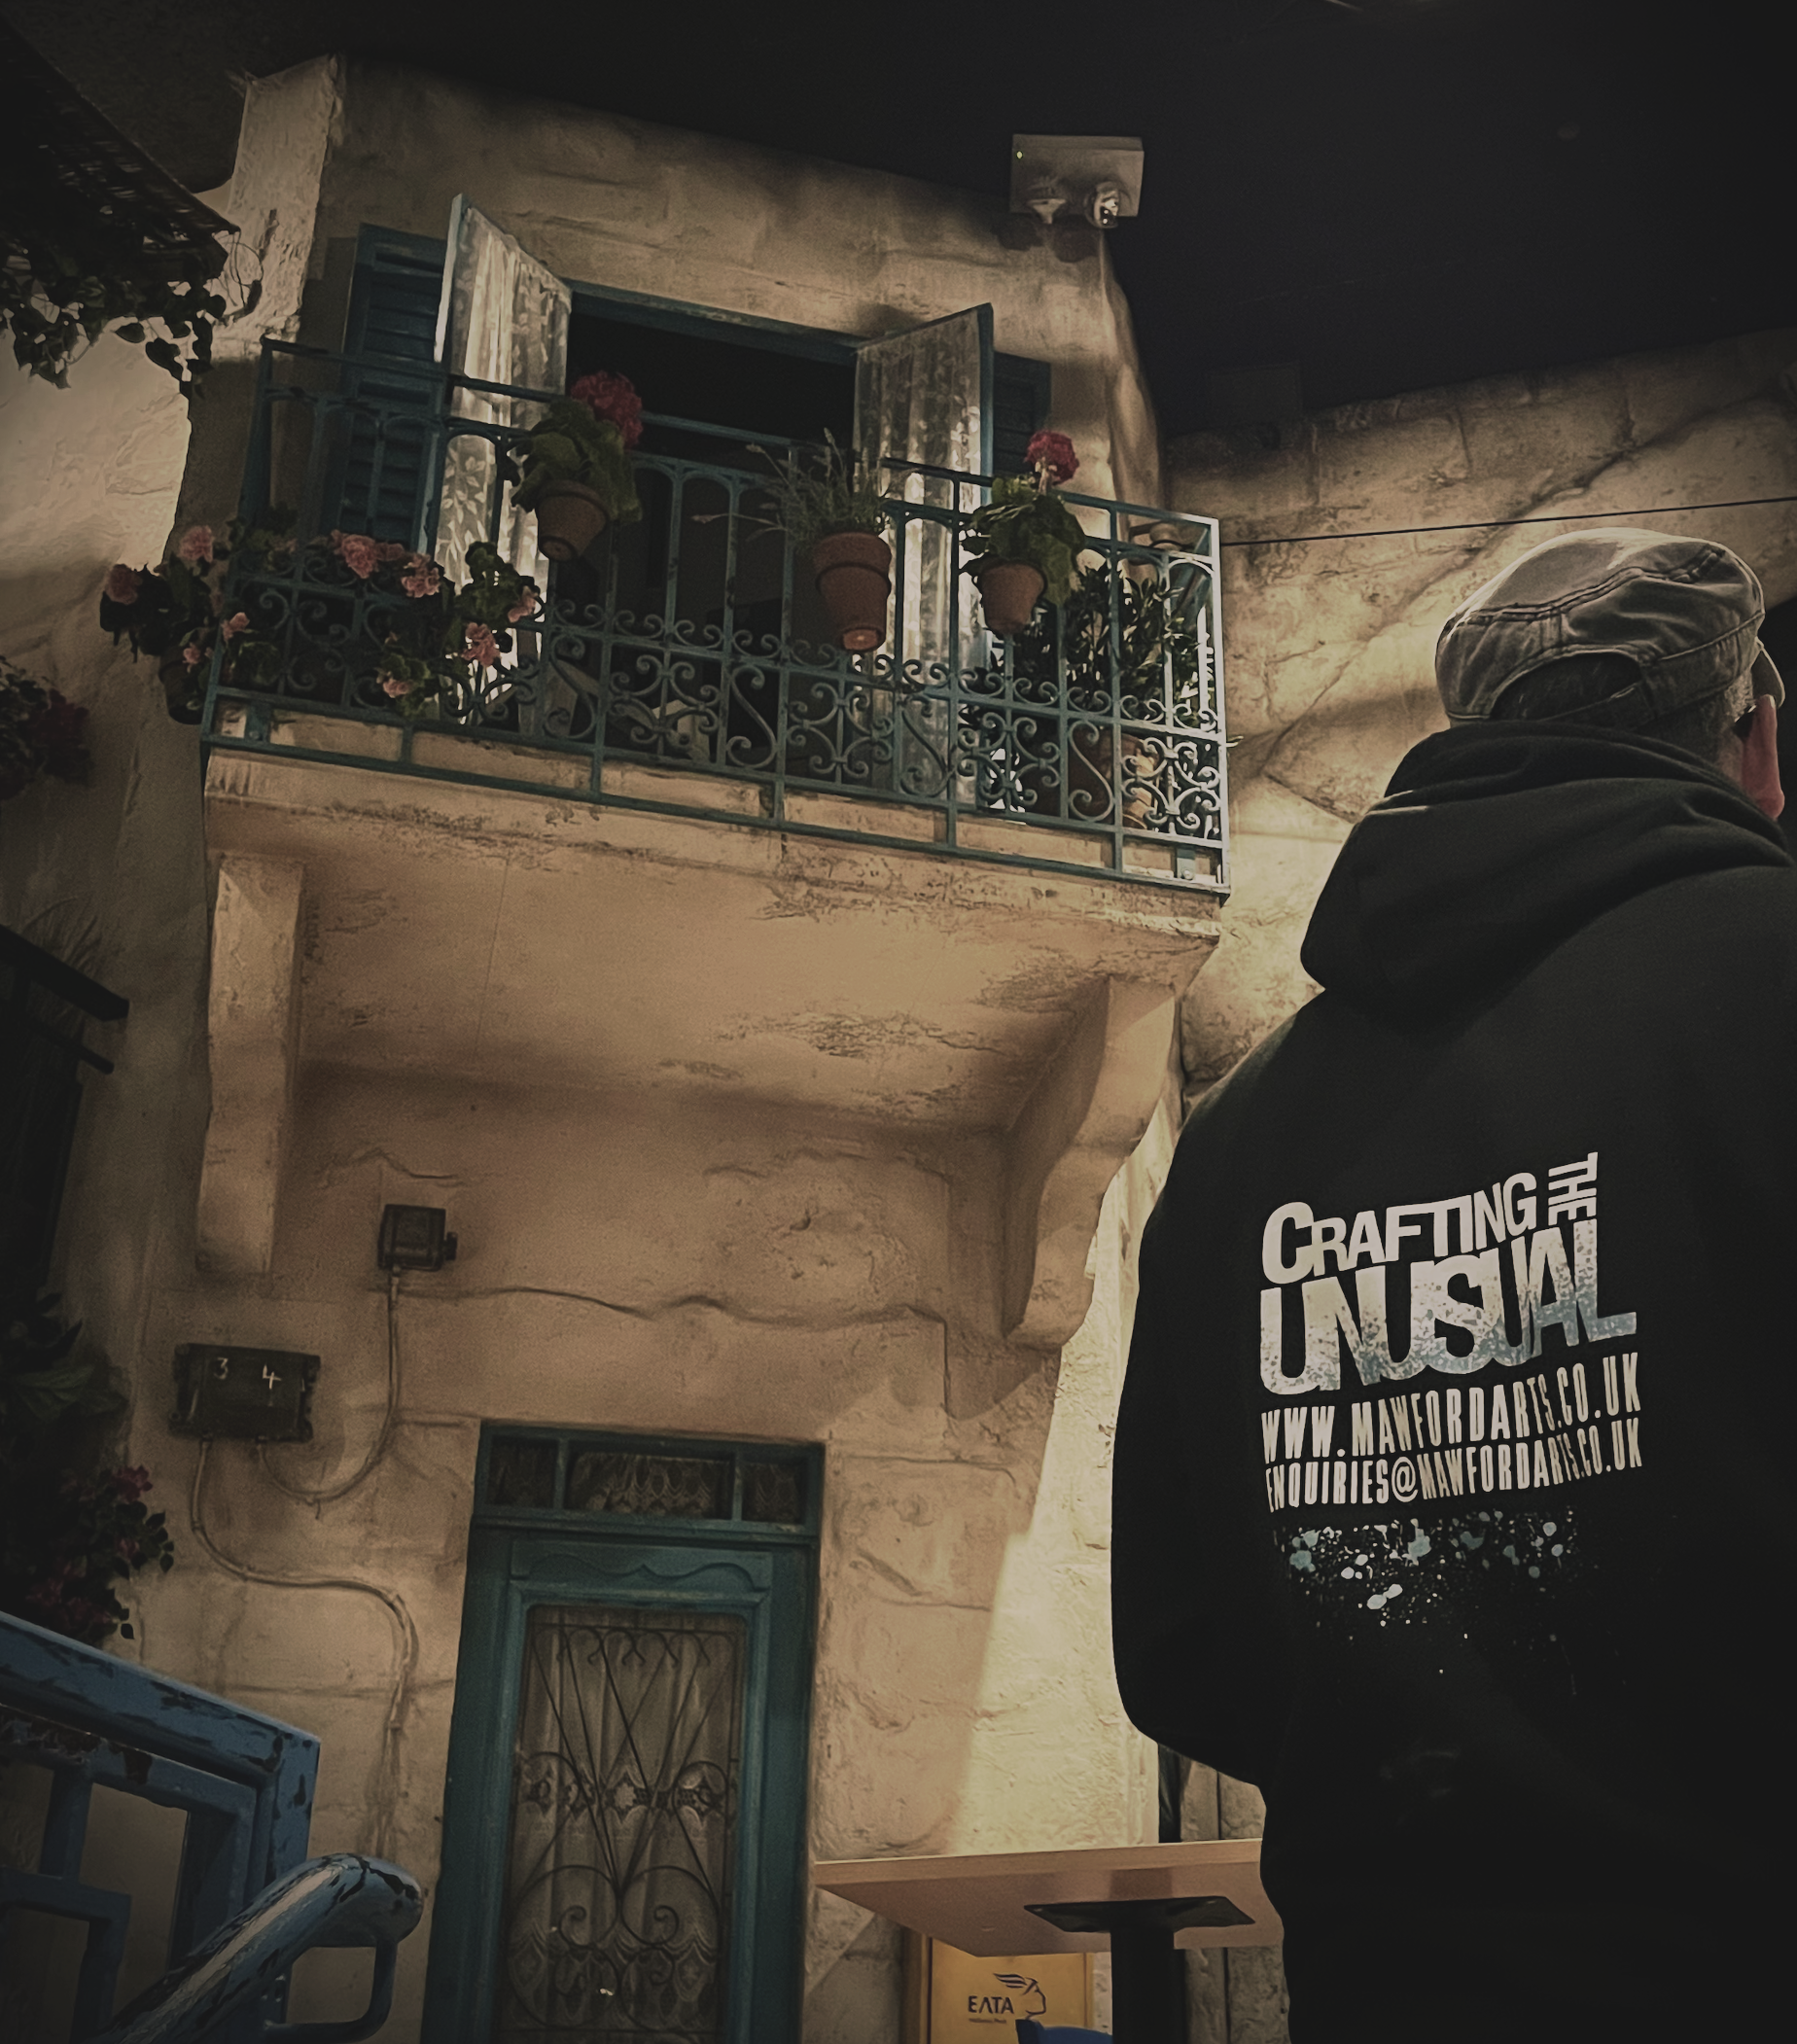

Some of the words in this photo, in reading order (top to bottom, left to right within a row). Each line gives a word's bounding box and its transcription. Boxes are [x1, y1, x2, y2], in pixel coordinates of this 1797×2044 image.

[1262, 1172, 1536, 1285] CRAFTING
[1548, 1151, 1598, 1226] THE
[1260, 1217, 1638, 1395] UNUSUAL
[213, 1357, 229, 1380] 3
[262, 1363, 282, 1390] 4
[1261, 1352, 1641, 1464] WWW.MAWFORDARTS.CO.UK
[1265, 1417, 1642, 1513] ENQUIRIES@MAWFORDARTS.CO.UK
